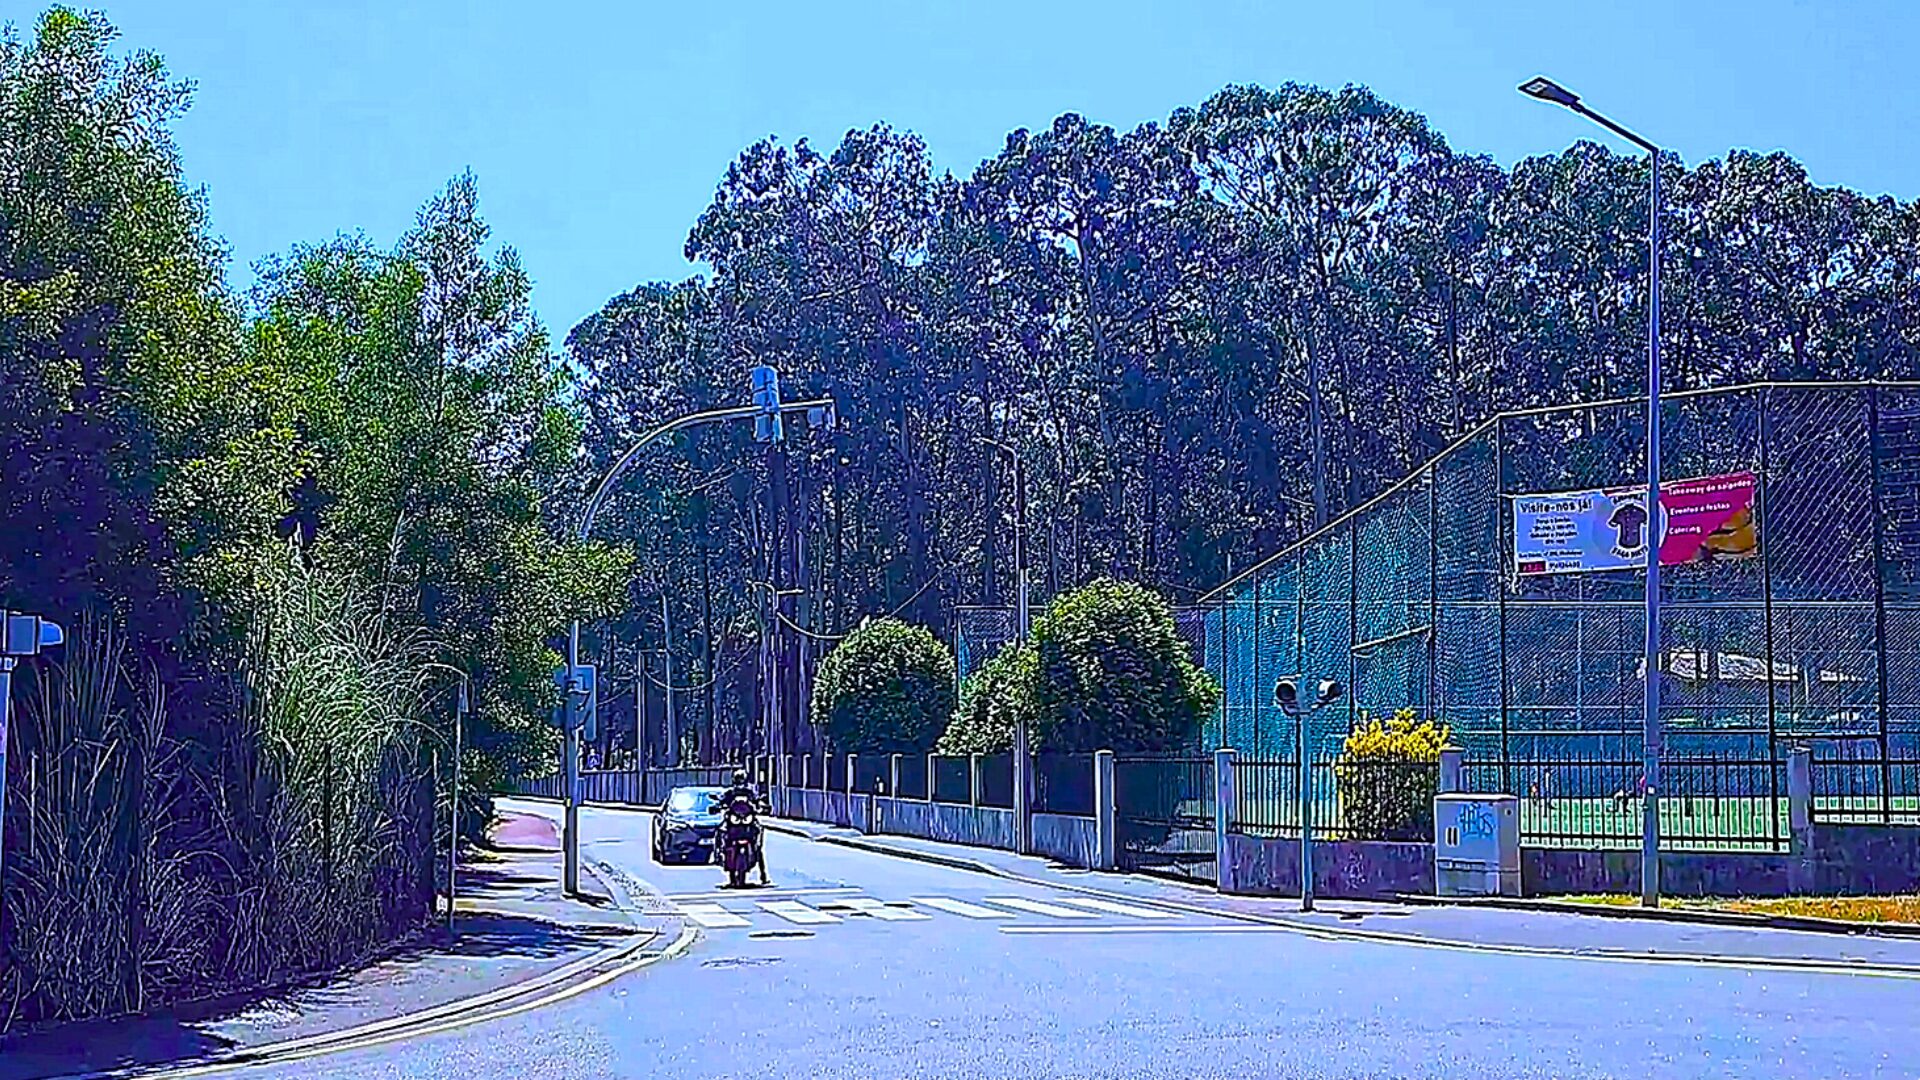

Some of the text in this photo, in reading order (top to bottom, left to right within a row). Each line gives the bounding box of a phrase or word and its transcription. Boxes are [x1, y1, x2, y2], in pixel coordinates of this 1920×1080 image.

[1520, 498, 1593, 513] Visite-nos já!
[1670, 506, 1699, 516] Eventos
[1705, 502, 1730, 512] festas
